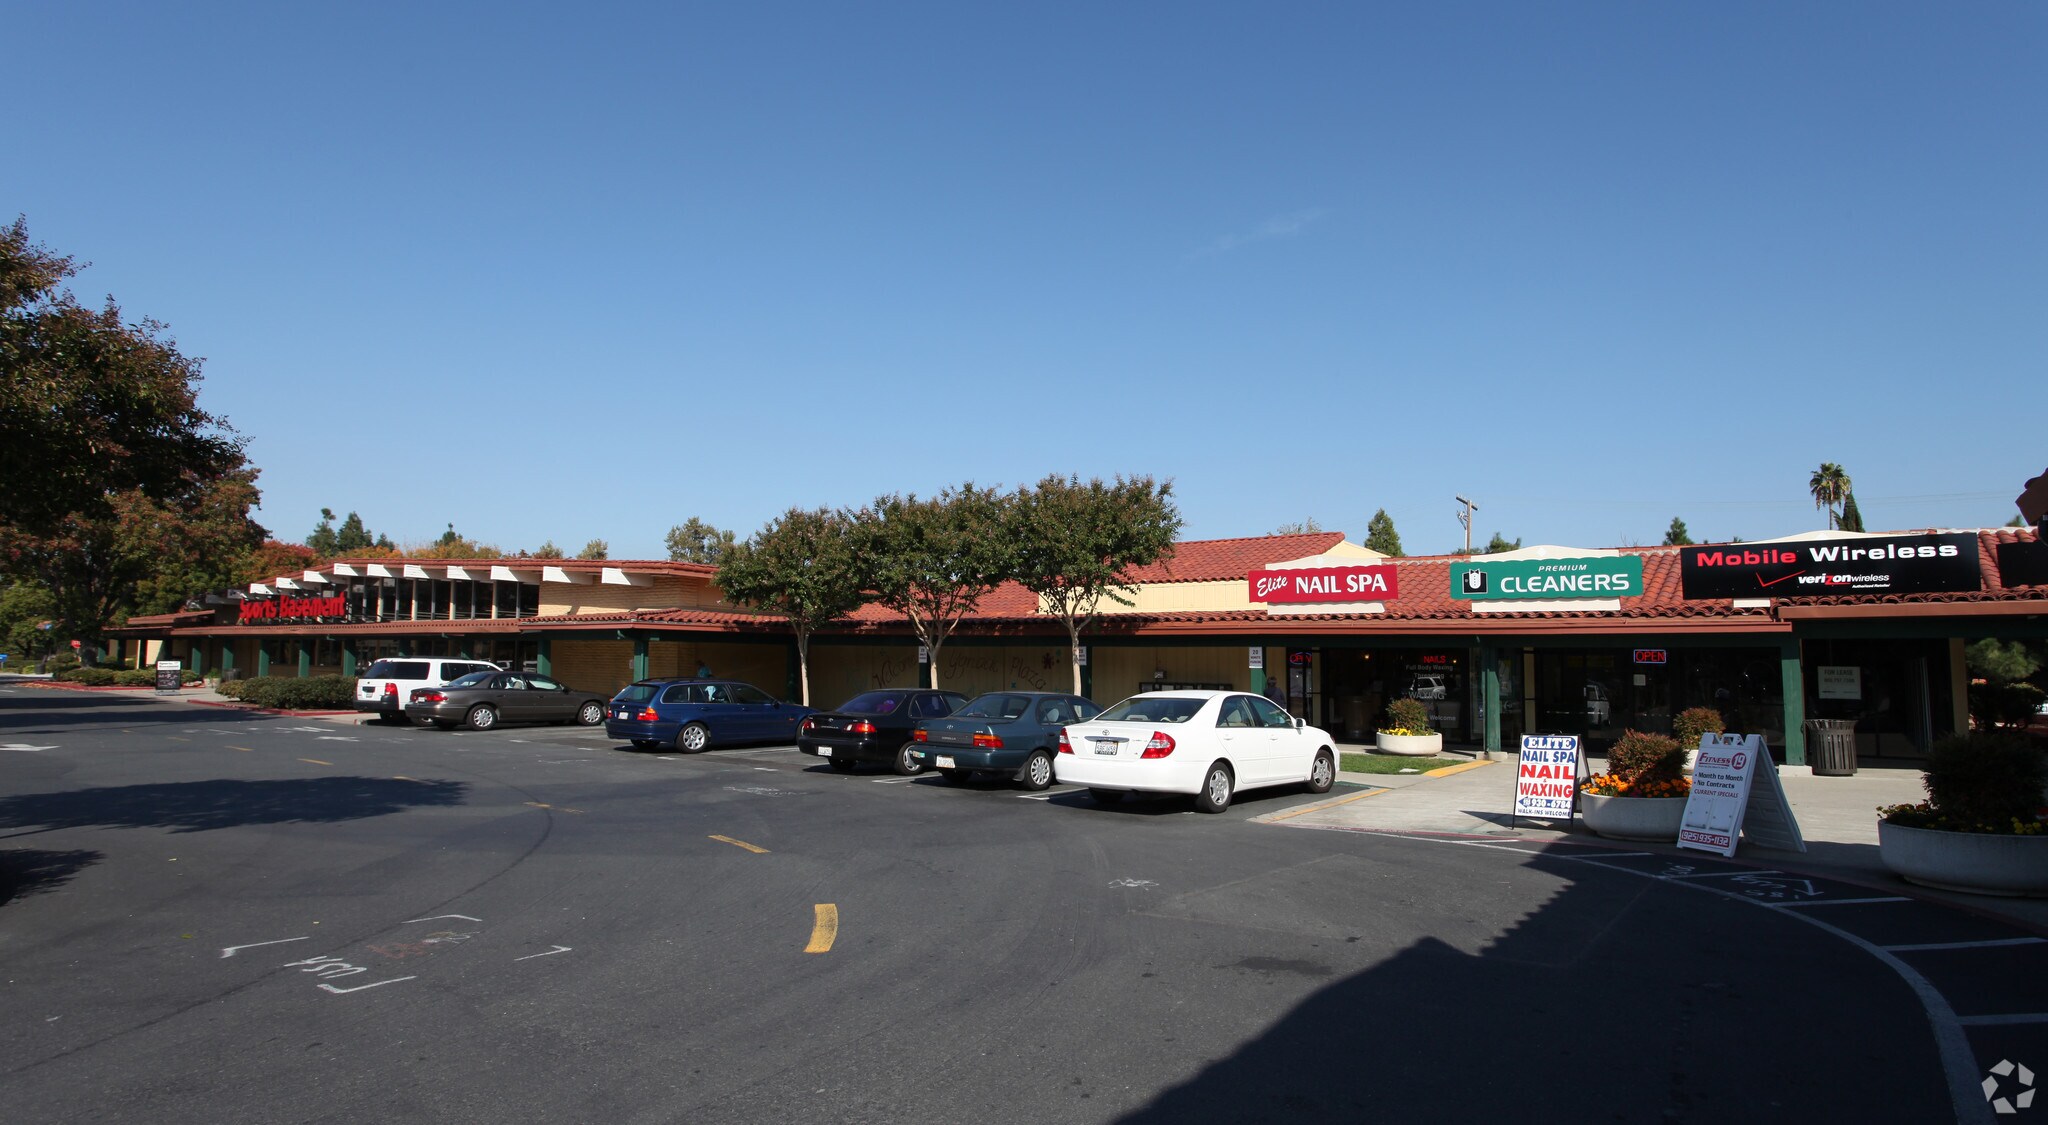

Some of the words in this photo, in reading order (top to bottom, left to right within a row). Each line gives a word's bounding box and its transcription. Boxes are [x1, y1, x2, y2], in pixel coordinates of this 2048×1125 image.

[1697, 549, 1797, 567] Mobile
[1809, 544, 1958, 562] Wireless
[1538, 564, 1587, 572] PREMIUM
[1256, 576, 1288, 597] Elite
[1296, 575, 1341, 594] NAIL
[1346, 573, 1387, 593] SPA
[1500, 573, 1630, 593] CLEANERS
[239, 599, 277, 624] Sports
[281, 591, 345, 617] Basement
[1423, 655, 1447, 663] NAILS
[1635, 651, 1665, 662] OPEN
[1408, 691, 1446, 700] WAXING
[1528, 737, 1572, 749] ELITE
[1522, 750, 1549, 762] NAIL
[1553, 751, 1575, 763] SPA
[1734, 753, 1744, 767] 19
[1521, 764, 1574, 779] NAIL
[1726, 774, 1743, 782] Month
[1520, 782, 1574, 798] WAXING
[1707, 781, 1735, 789] Contracts
[1718, 790, 1739, 798] SPECIALS
